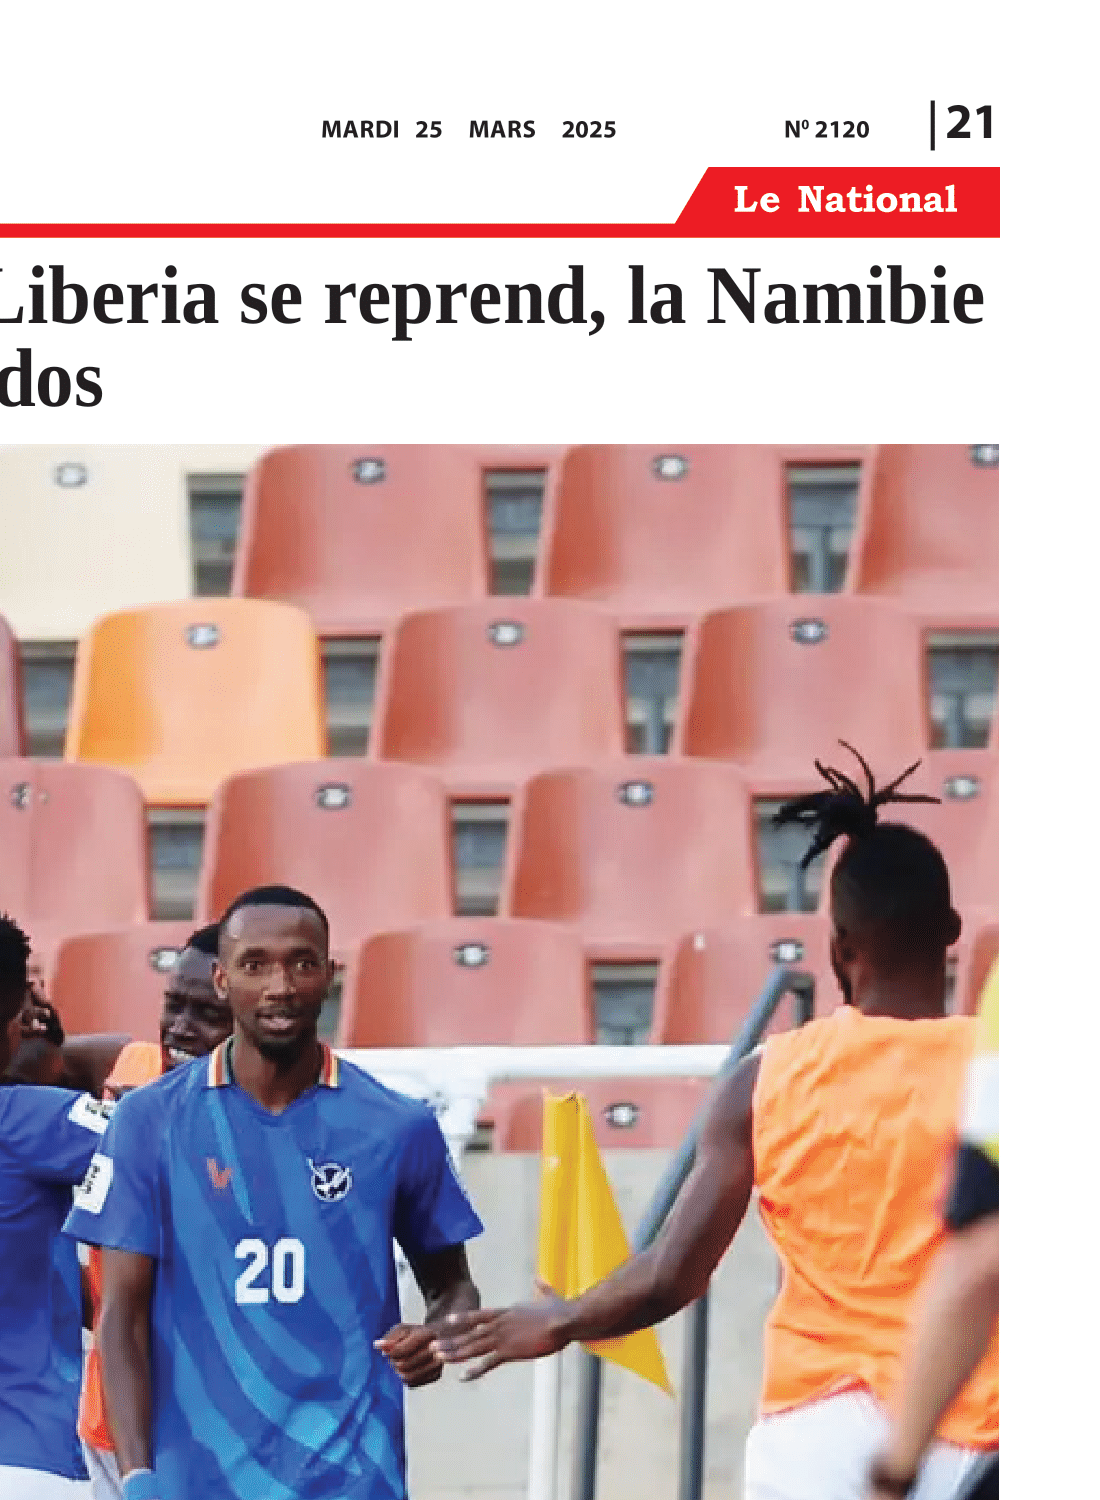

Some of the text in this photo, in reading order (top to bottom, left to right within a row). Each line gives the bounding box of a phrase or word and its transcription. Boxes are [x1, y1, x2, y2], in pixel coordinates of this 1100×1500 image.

[321, 119, 617, 139] MARDI 25 MARS 2025
[946, 104, 992, 139] 21
[734, 184, 958, 213] Le National
[240, 283, 302, 325] se
[324, 264, 605, 342] reprend,
[627, 264, 686, 325] la
[706, 264, 984, 325] Namibie
[234, 1237, 306, 1305] 20
